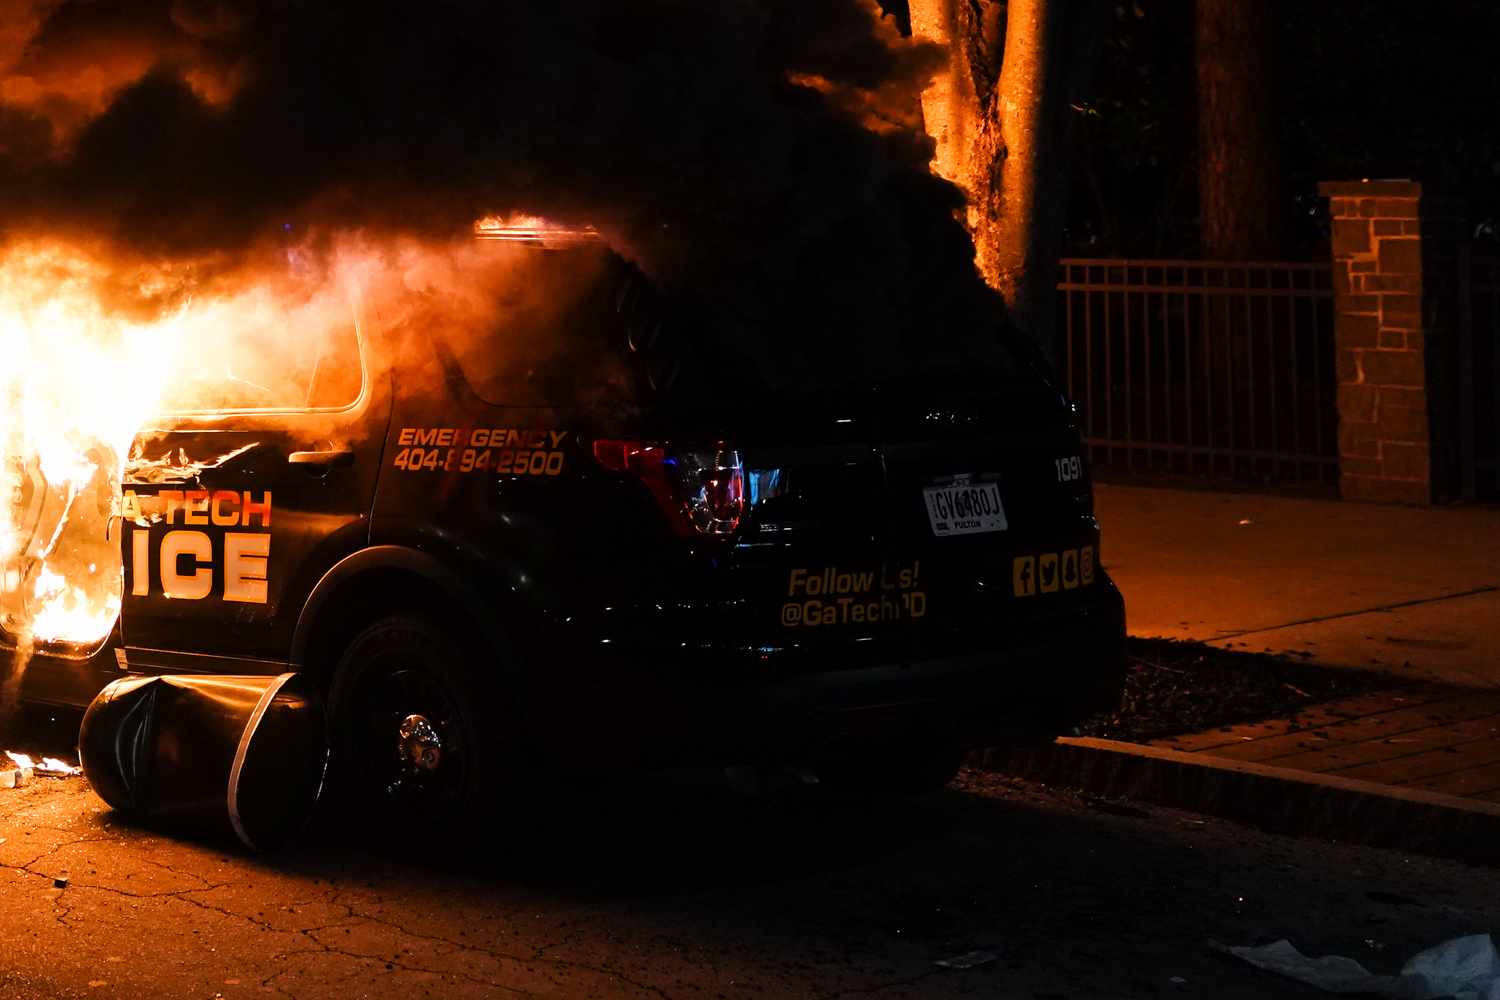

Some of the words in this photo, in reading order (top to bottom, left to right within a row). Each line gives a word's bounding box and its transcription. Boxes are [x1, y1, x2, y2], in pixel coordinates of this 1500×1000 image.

[397, 428, 568, 449] EMERGENCY
[158, 490, 272, 527] TECH
[954, 520, 982, 529] FULTON
[132, 530, 271, 603] ICE
[788, 566, 874, 597] Follow
